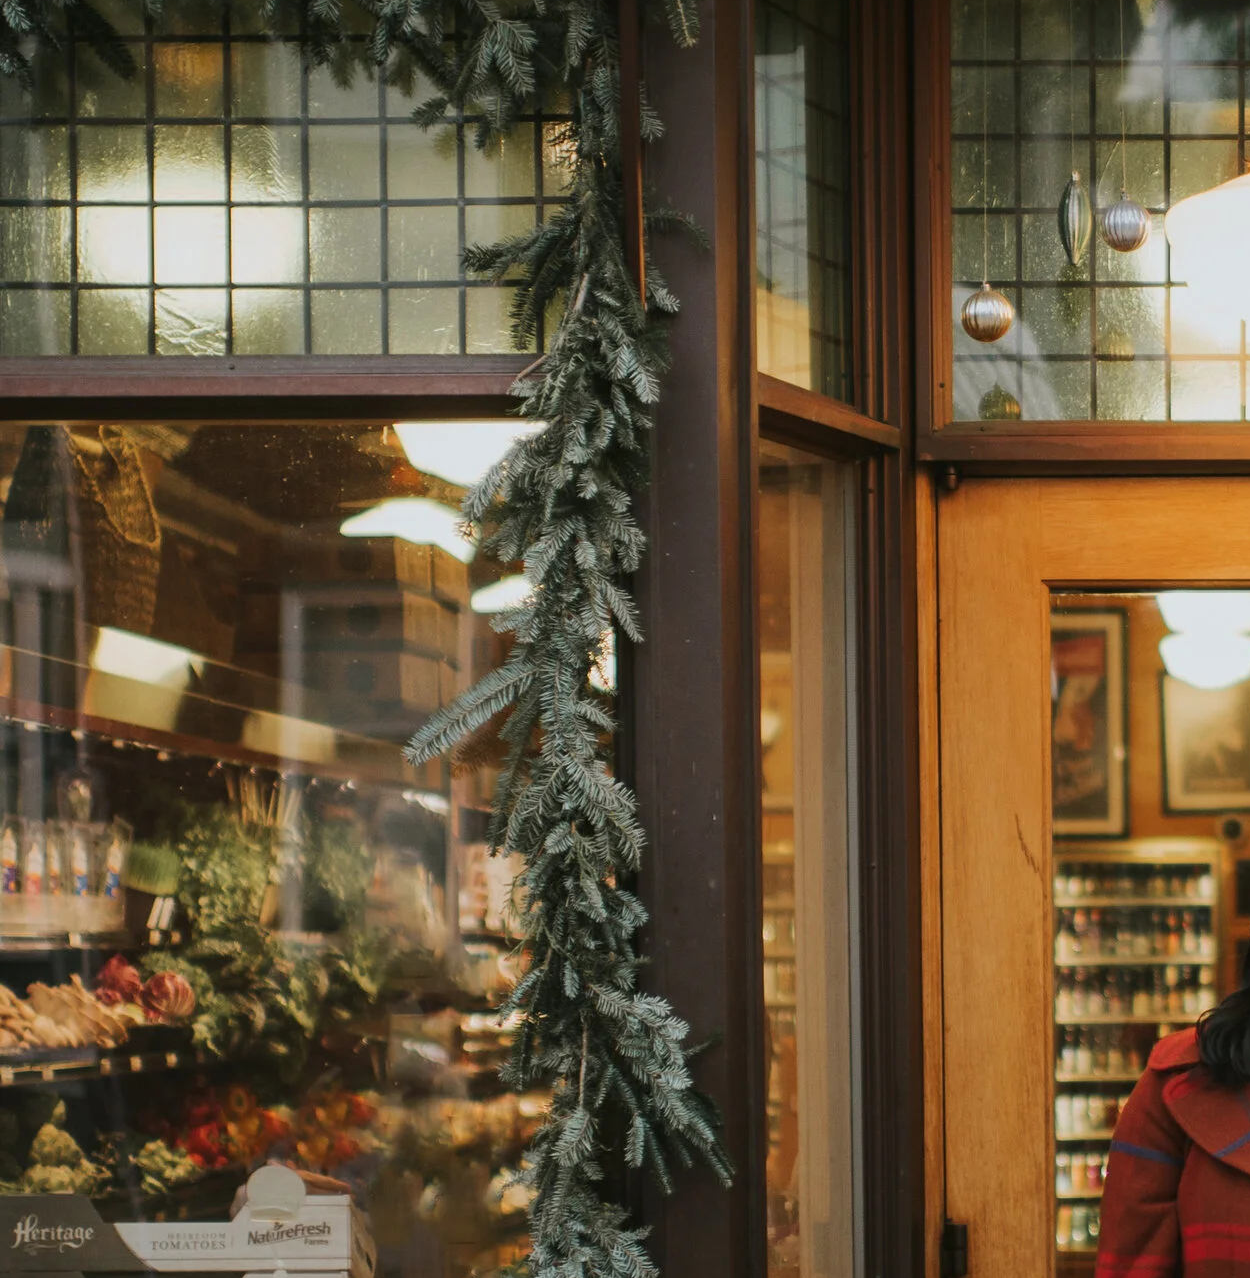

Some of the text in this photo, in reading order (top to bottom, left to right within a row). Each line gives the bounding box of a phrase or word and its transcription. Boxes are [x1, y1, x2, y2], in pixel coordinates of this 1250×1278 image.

[10, 1214, 94, 1252] Heritage
[248, 1222, 332, 1246] NatureFresh
[150, 1240, 226, 1251] TOMATOES
[304, 1238, 329, 1246] Farms
